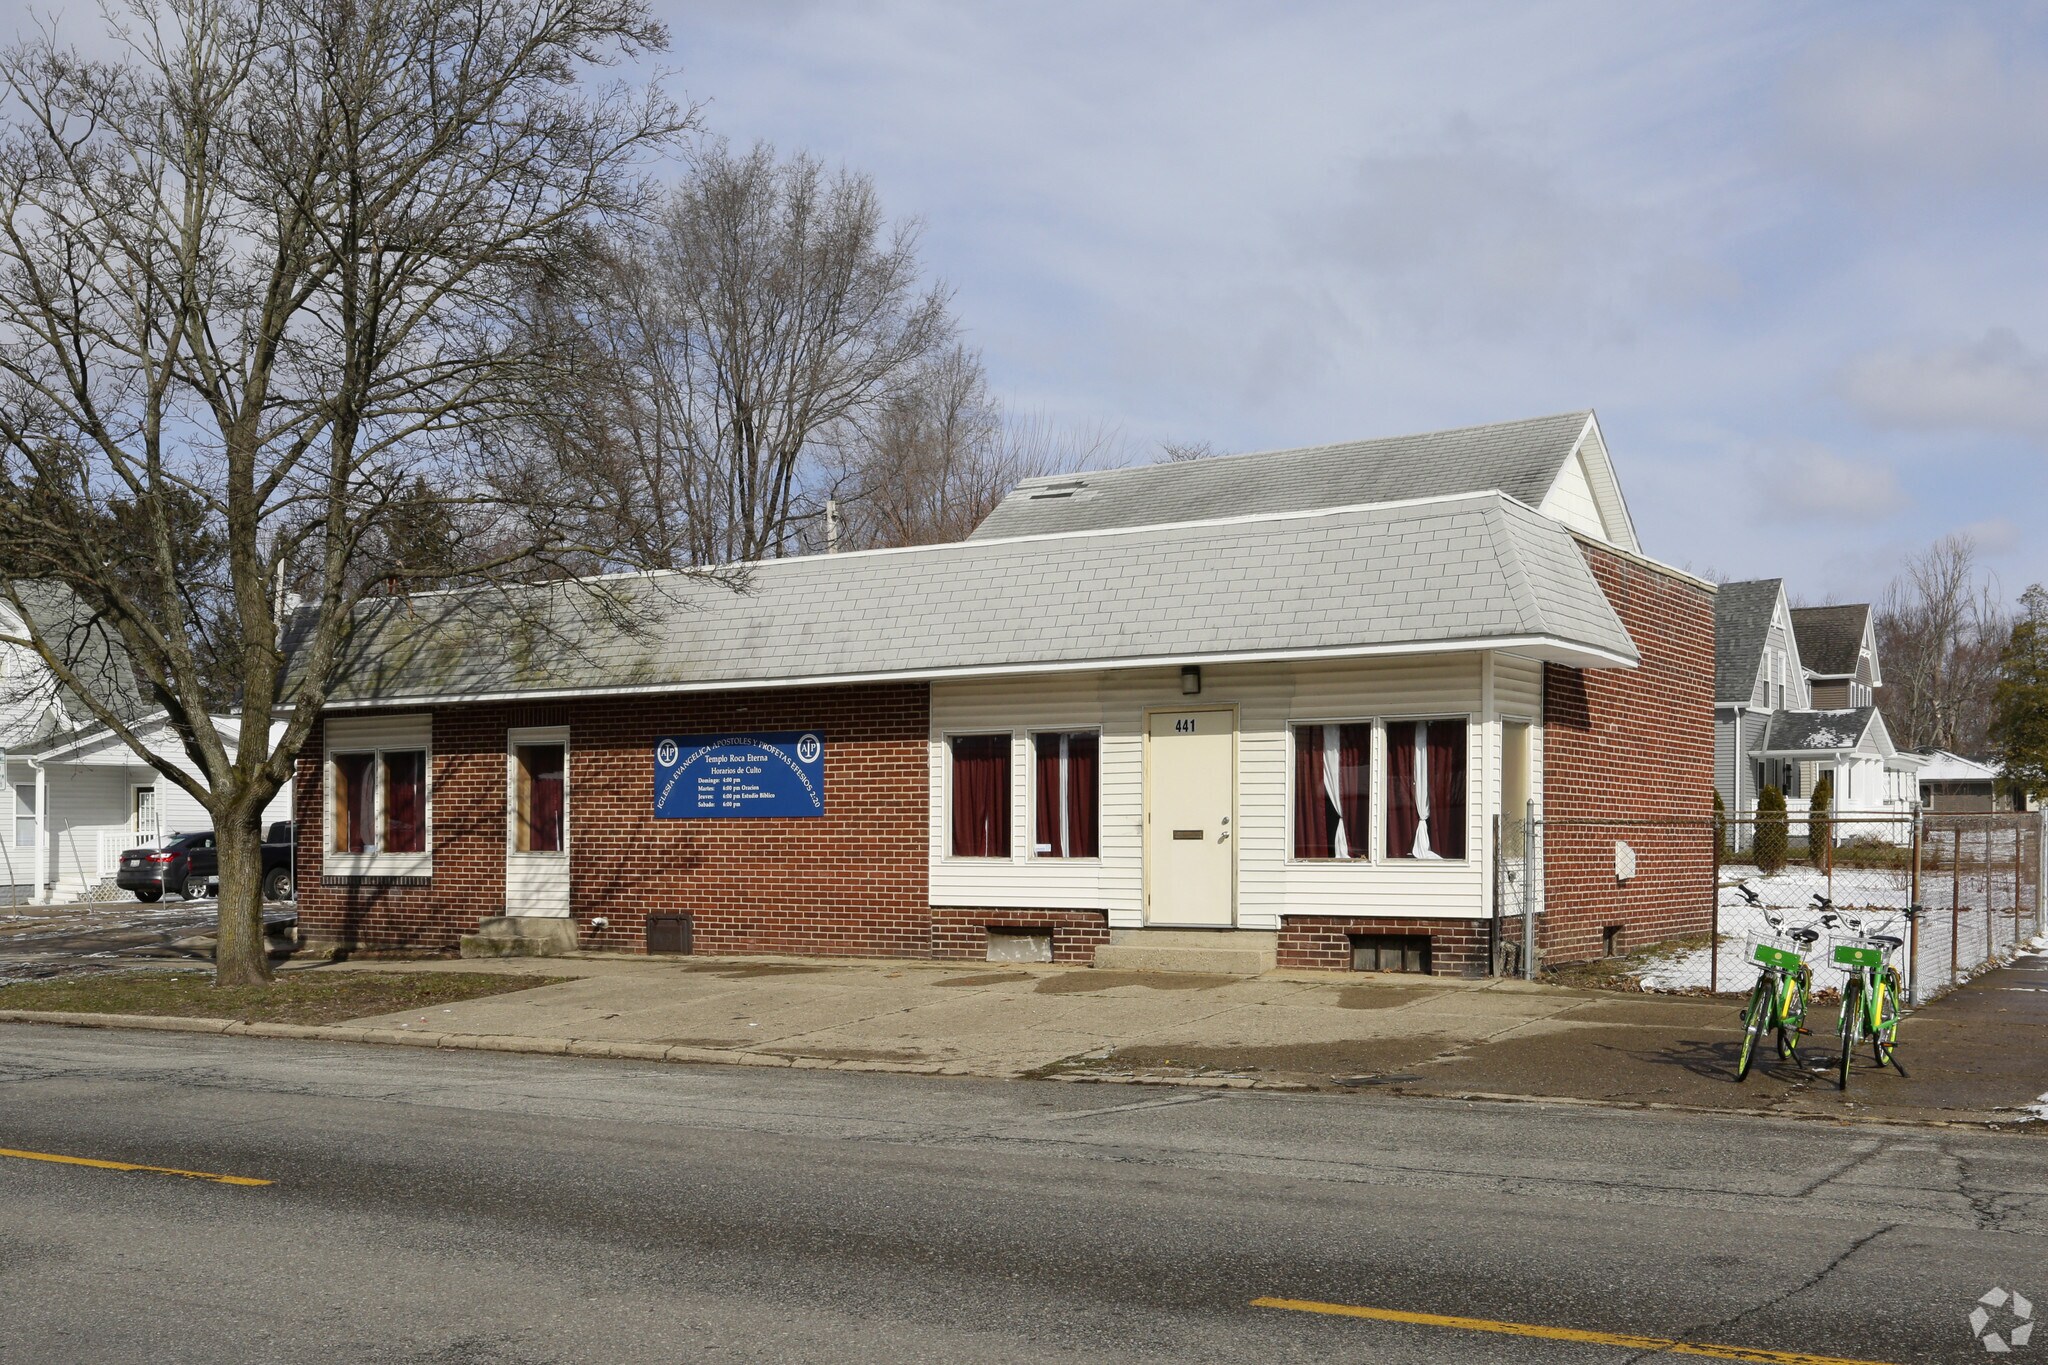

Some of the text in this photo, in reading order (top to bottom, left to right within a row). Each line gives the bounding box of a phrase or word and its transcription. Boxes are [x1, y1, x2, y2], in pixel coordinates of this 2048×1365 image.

[1175, 719, 1195, 732] 441
[704, 753, 768, 765] Templo Roca Eterna
[657, 737, 821, 809] IGLESIA EVANGELICA APOSTOLES Y PROFETAS EFESIOS 2:20
[711, 767, 736, 775] Horarios
[745, 766, 761, 774] Culto
